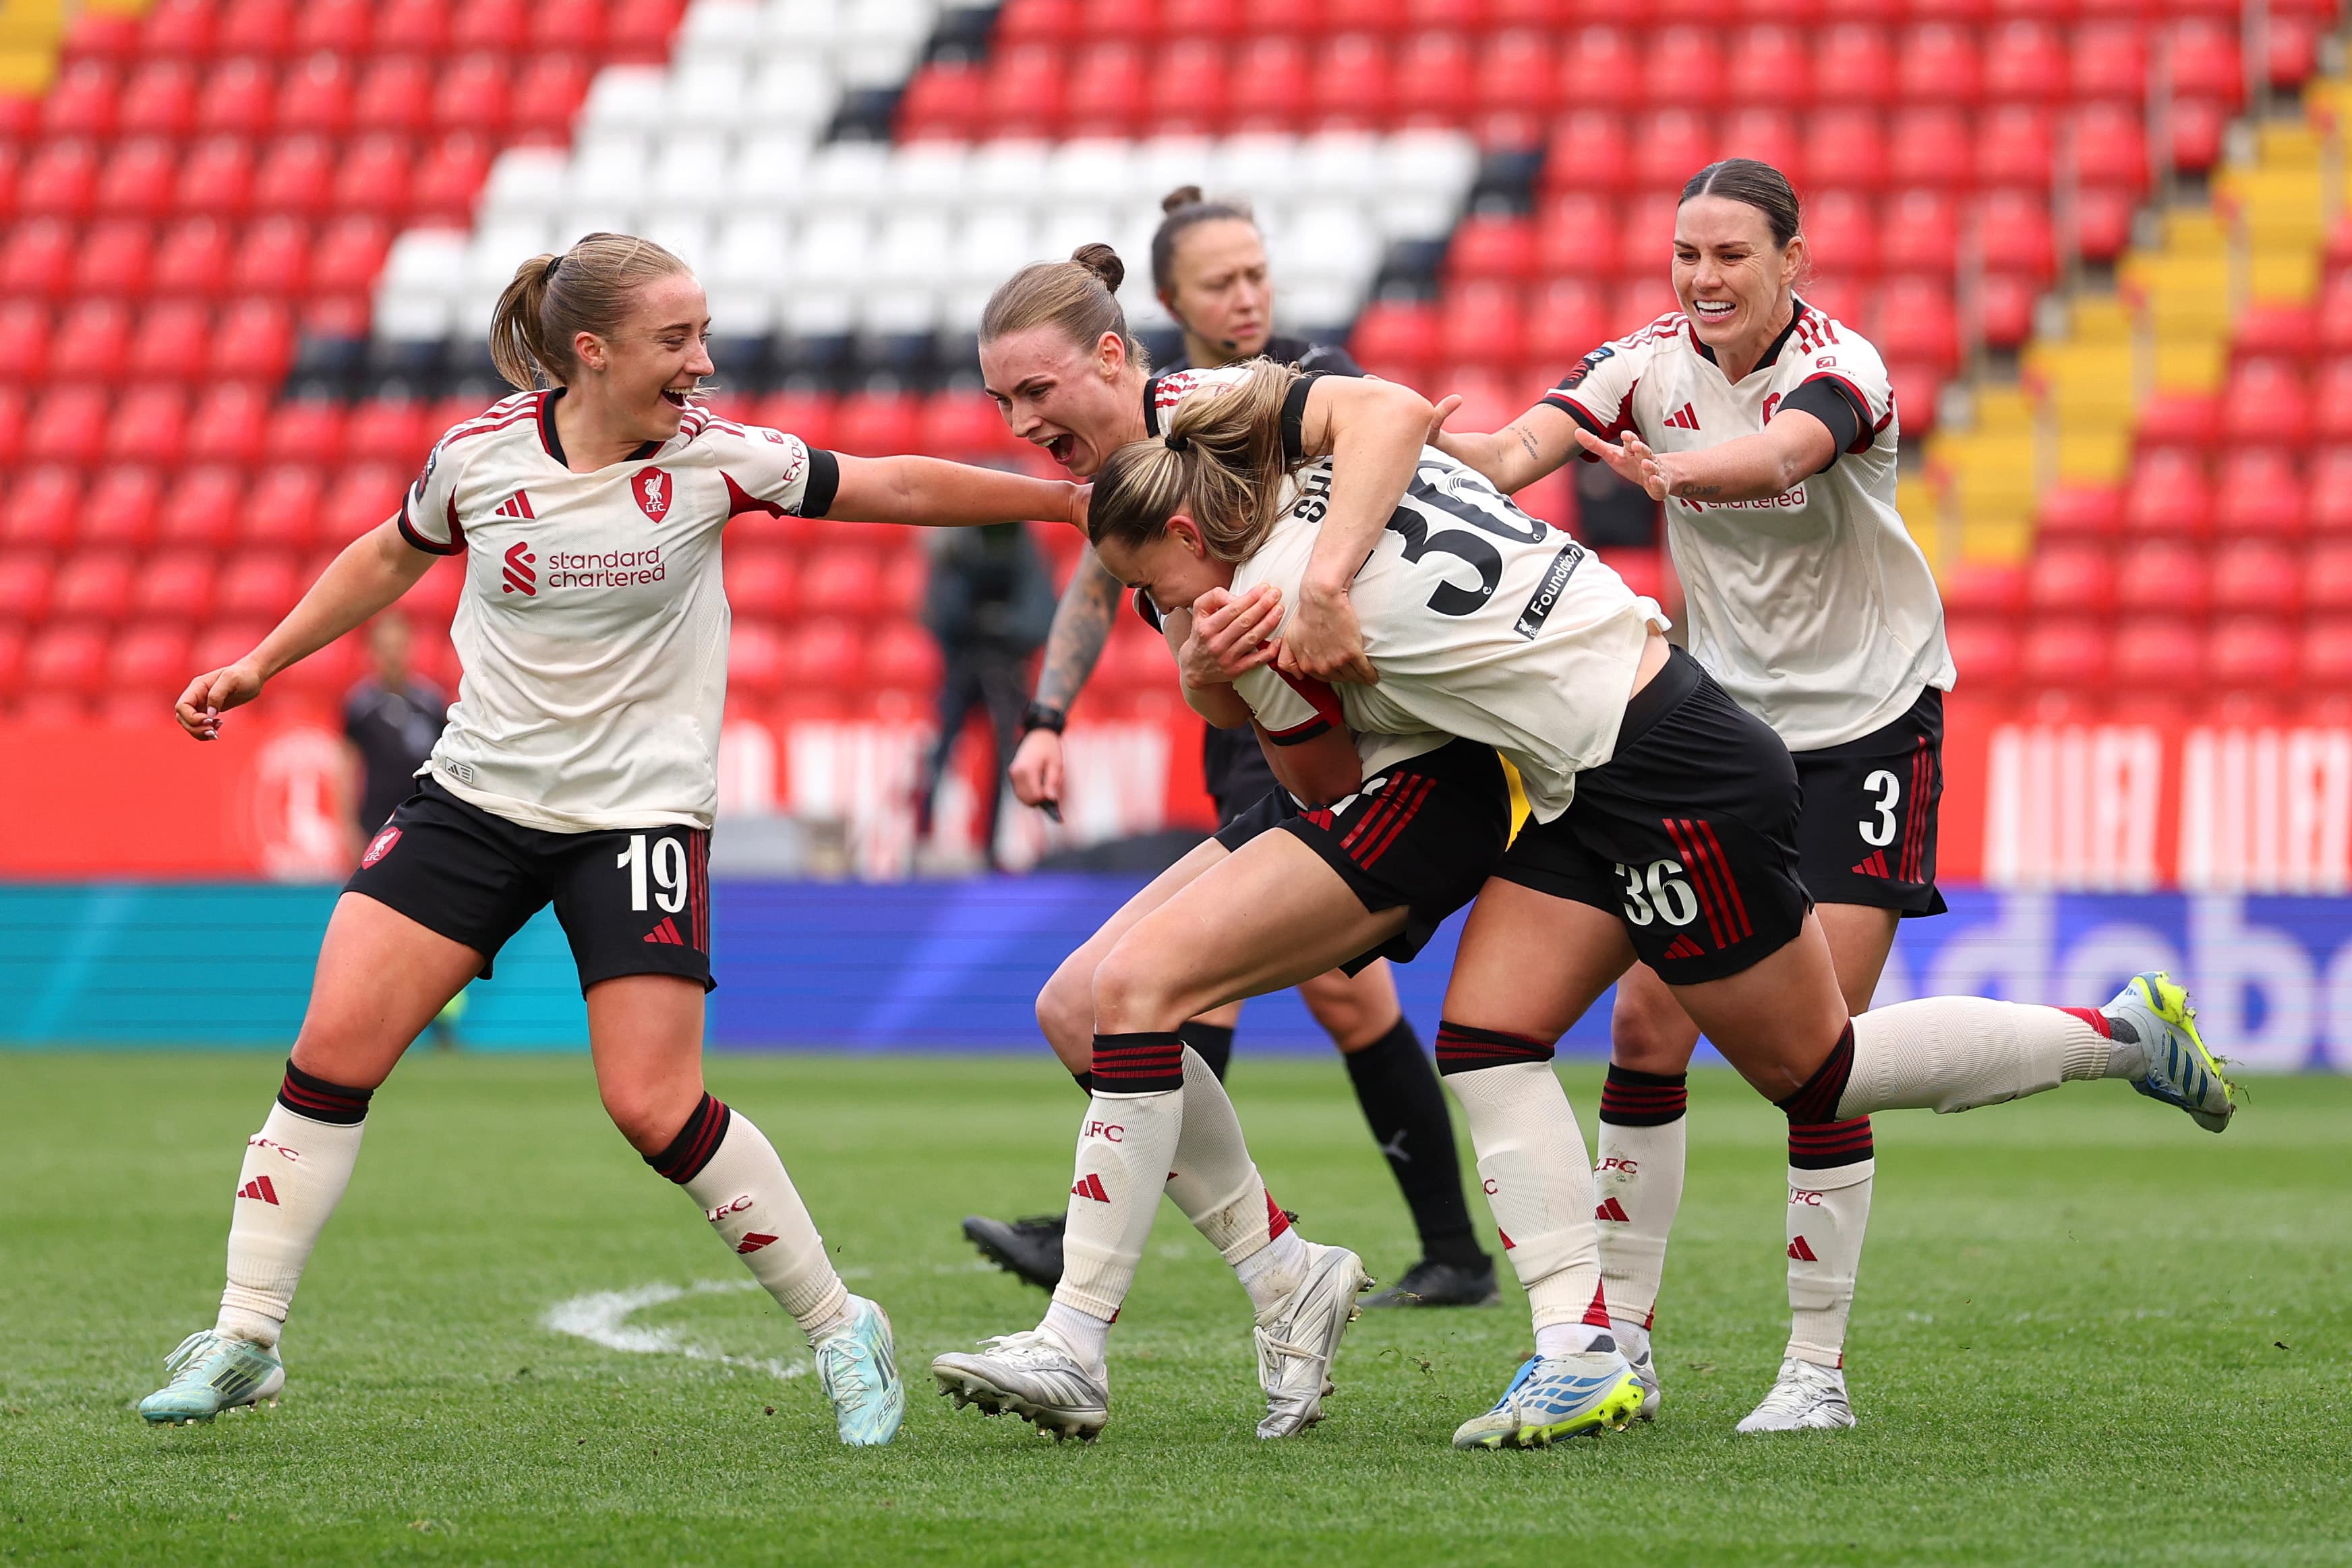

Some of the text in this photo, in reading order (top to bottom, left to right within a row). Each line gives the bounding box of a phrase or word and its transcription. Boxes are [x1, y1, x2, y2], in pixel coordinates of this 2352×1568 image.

[1353, 460, 1548, 616] 36
[549, 546, 659, 570] standard
[549, 562, 666, 588] chartered
[1530, 547, 1581, 616] Foundation
[1859, 770, 1900, 847] 3
[617, 835, 688, 913] 19
[1615, 859, 1698, 926] 36
[1868, 884, 2352, 1072] dob
[1084, 1120, 1125, 1143] LFC
[1594, 1157, 1638, 1174] LFC
[705, 1195, 753, 1223] LFC
[1788, 1188, 1823, 1207] LFC
[877, 1391, 898, 1426] F50
